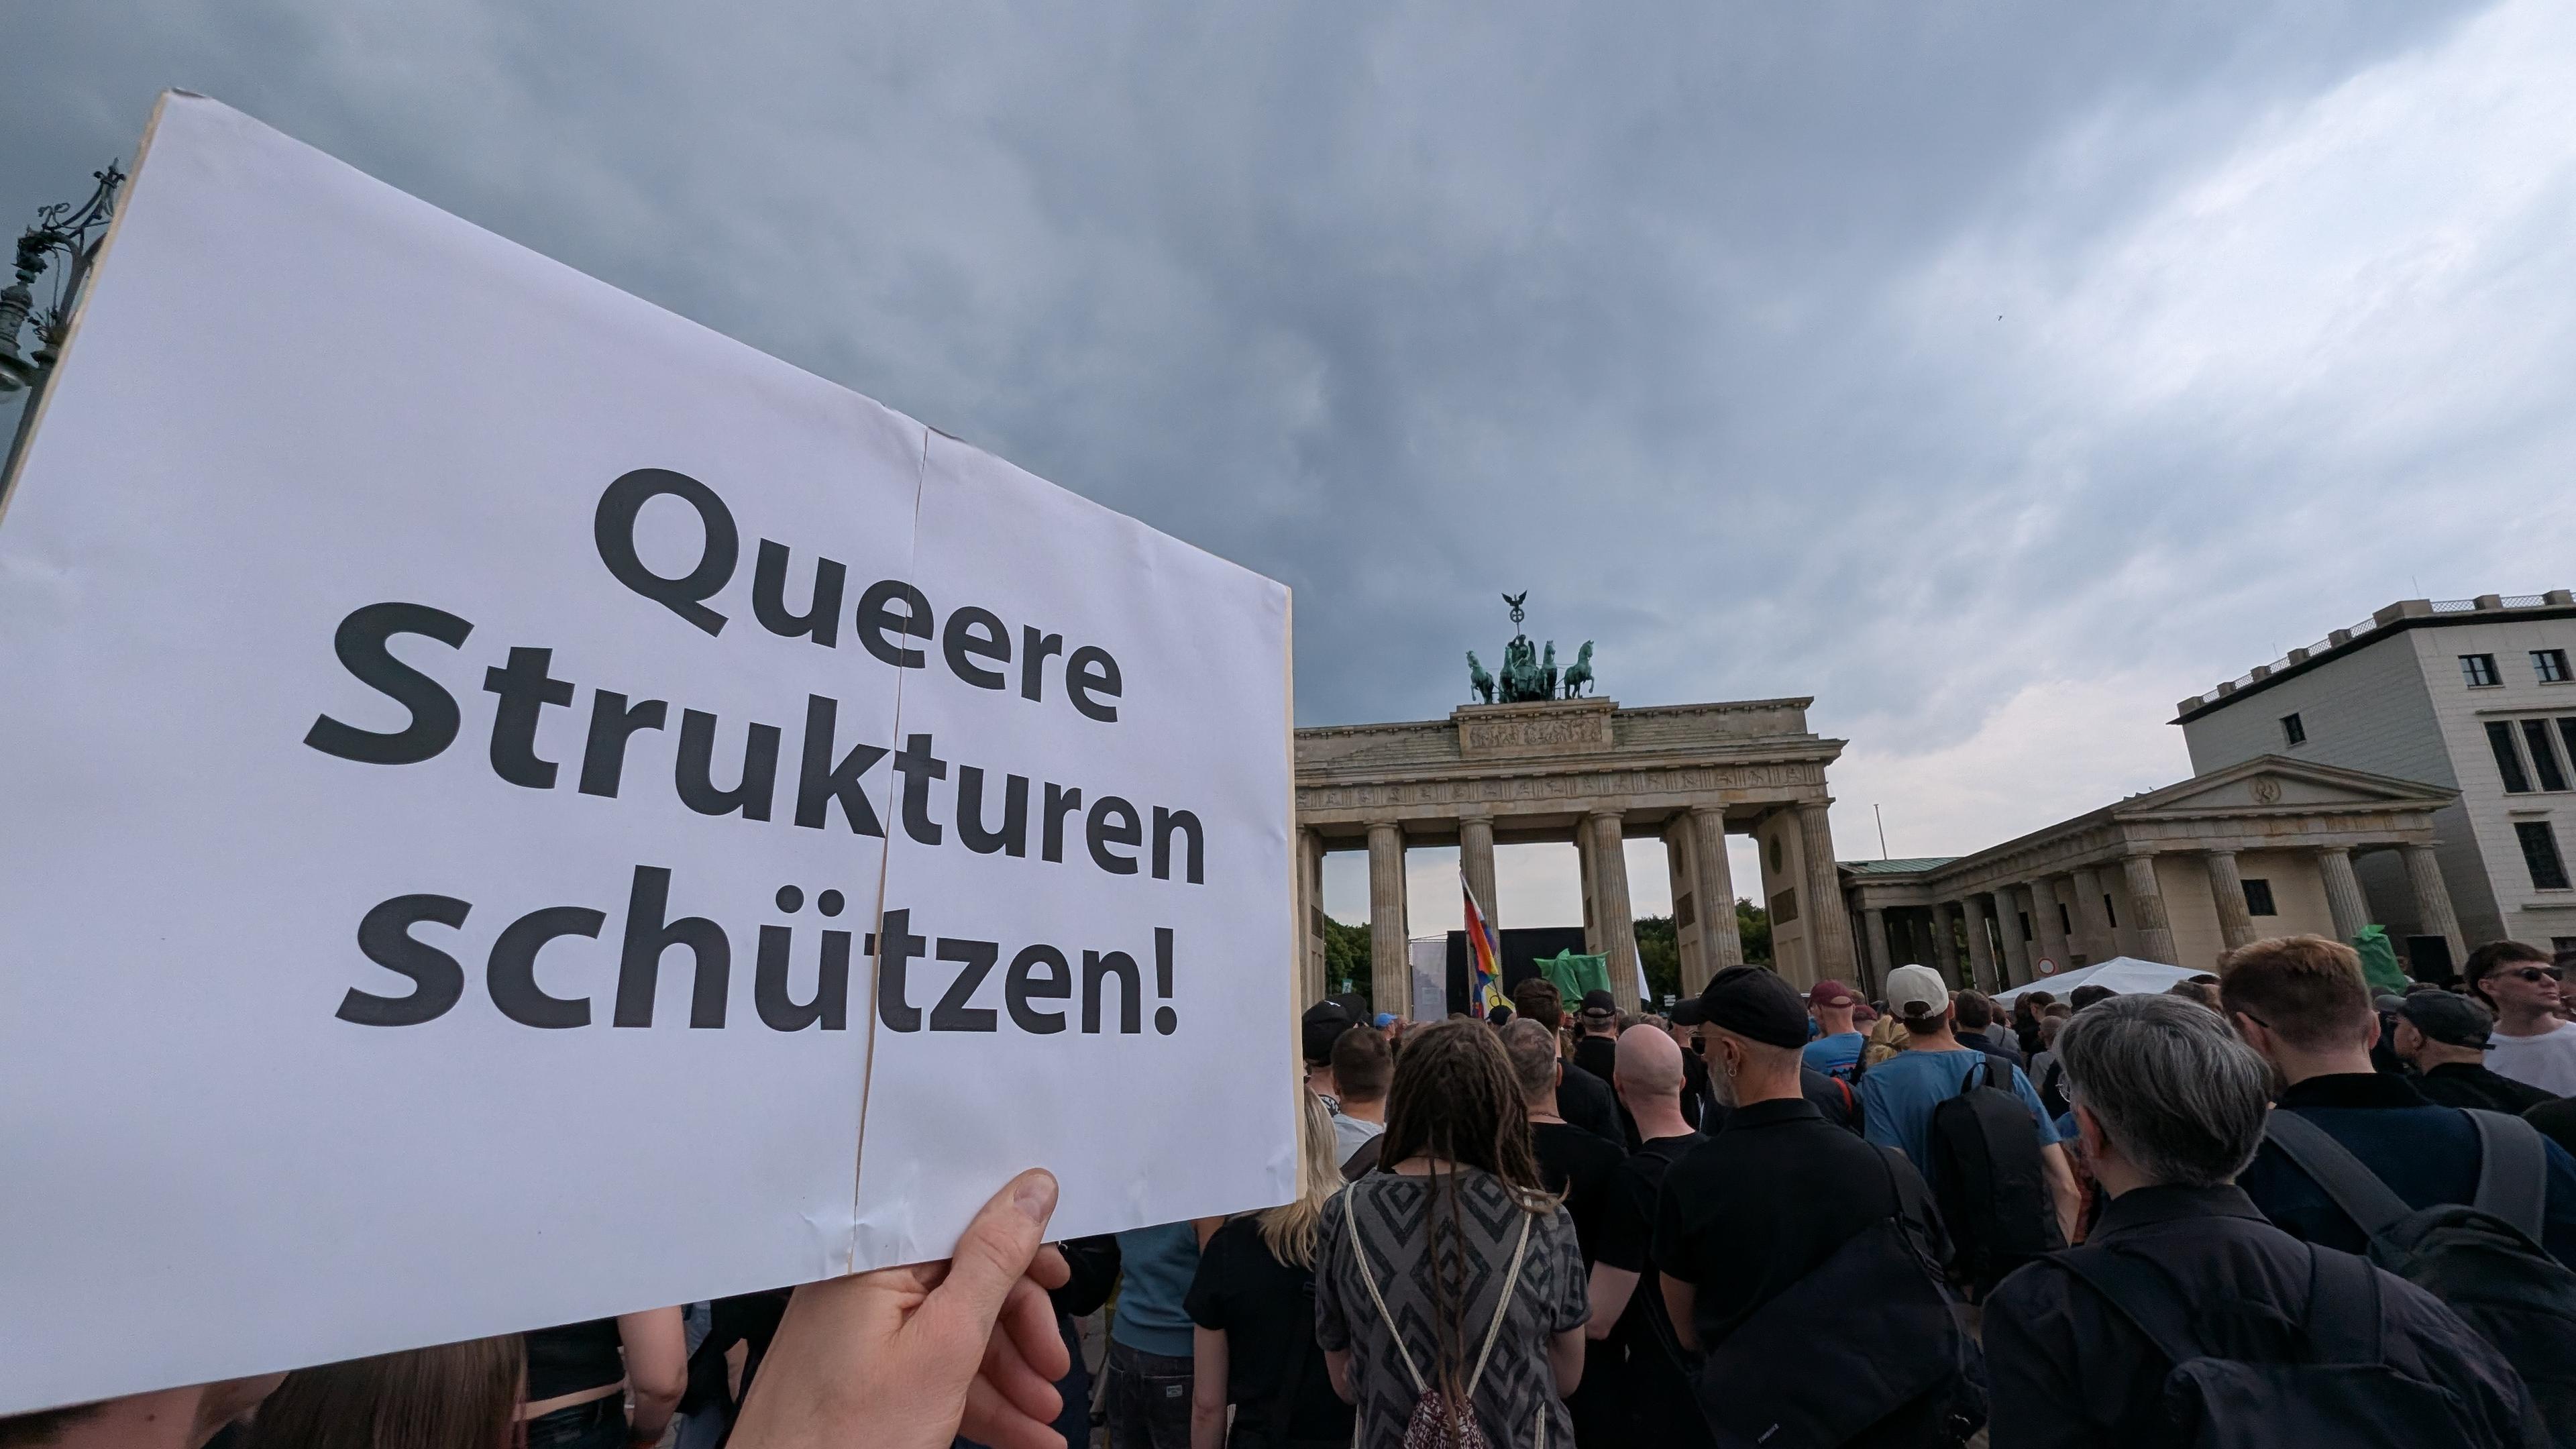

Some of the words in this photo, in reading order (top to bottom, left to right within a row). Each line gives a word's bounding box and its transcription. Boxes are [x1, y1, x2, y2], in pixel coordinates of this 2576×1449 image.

[594, 468, 1124, 723] Queere
[303, 602, 1205, 885] Strukturen
[334, 864, 1178, 1036] schützen!
